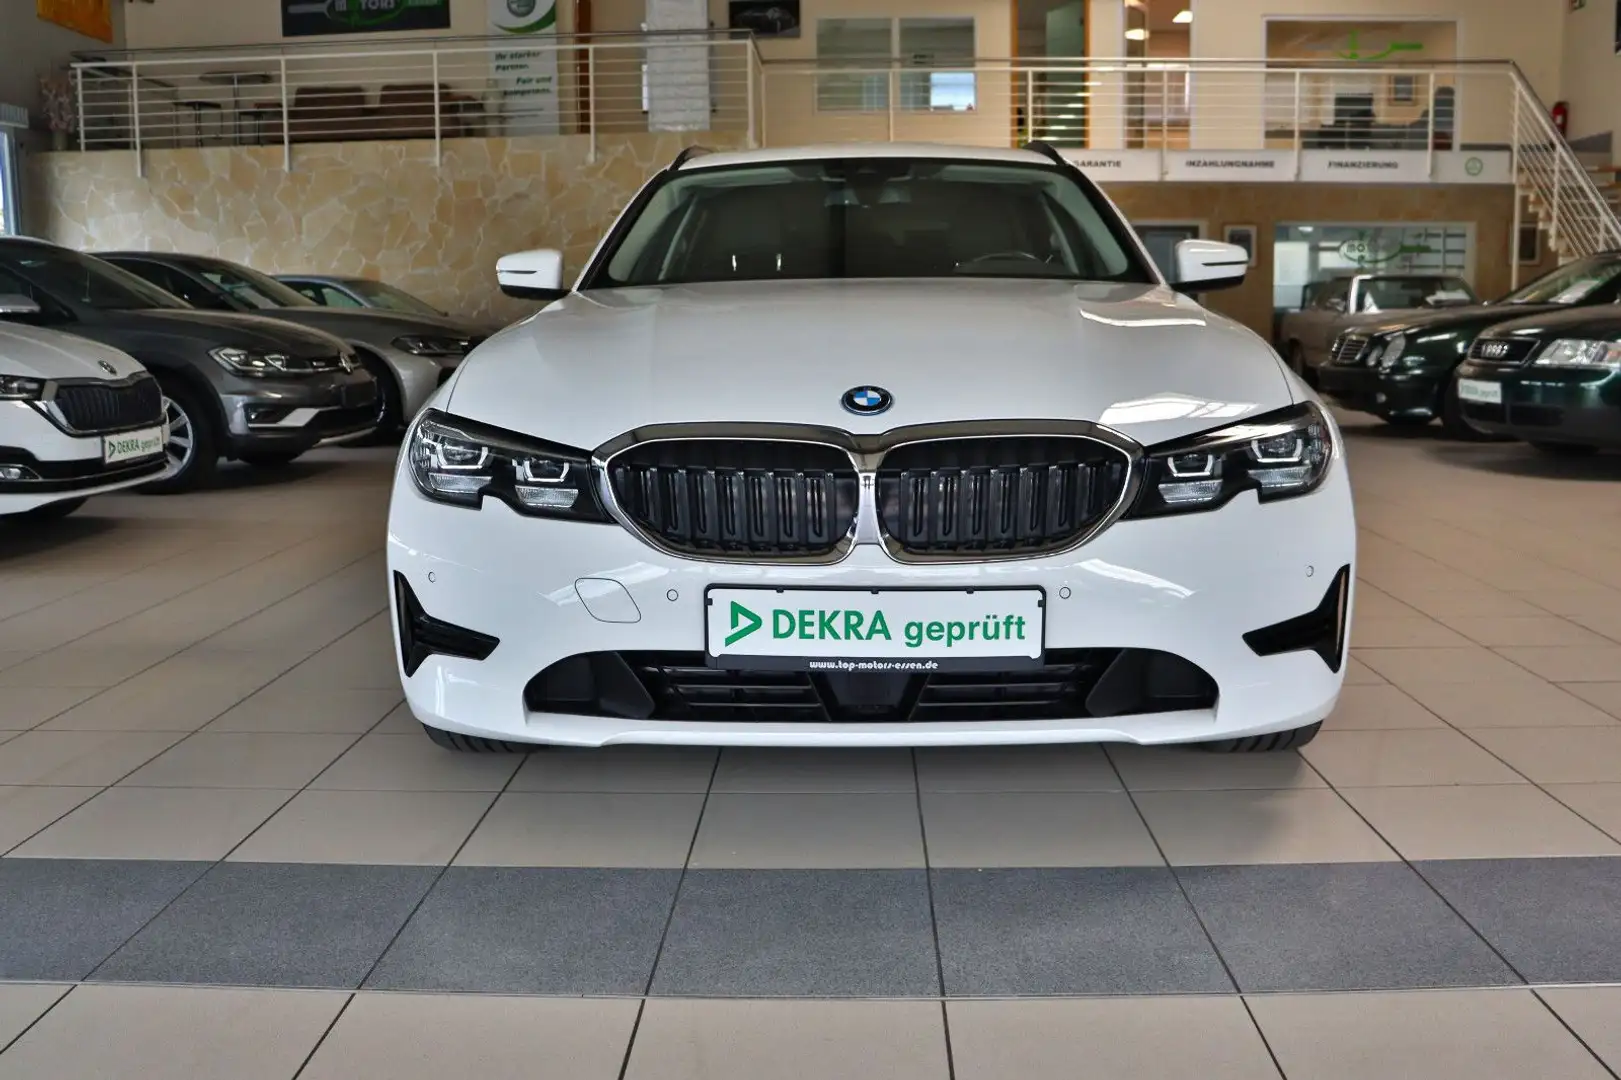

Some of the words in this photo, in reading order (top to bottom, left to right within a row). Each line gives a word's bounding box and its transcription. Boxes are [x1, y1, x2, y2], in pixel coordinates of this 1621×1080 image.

[1185, 160, 1275, 168] INZAHLUNGNAHME
[1328, 160, 1399, 169] FINANZIERUNG
[117, 438, 140, 454] DEKRA
[772, 609, 892, 641] DEKRA
[904, 614, 1026, 648] geprüft
[809, 660, 939, 671] www.top-motors-essen.de
